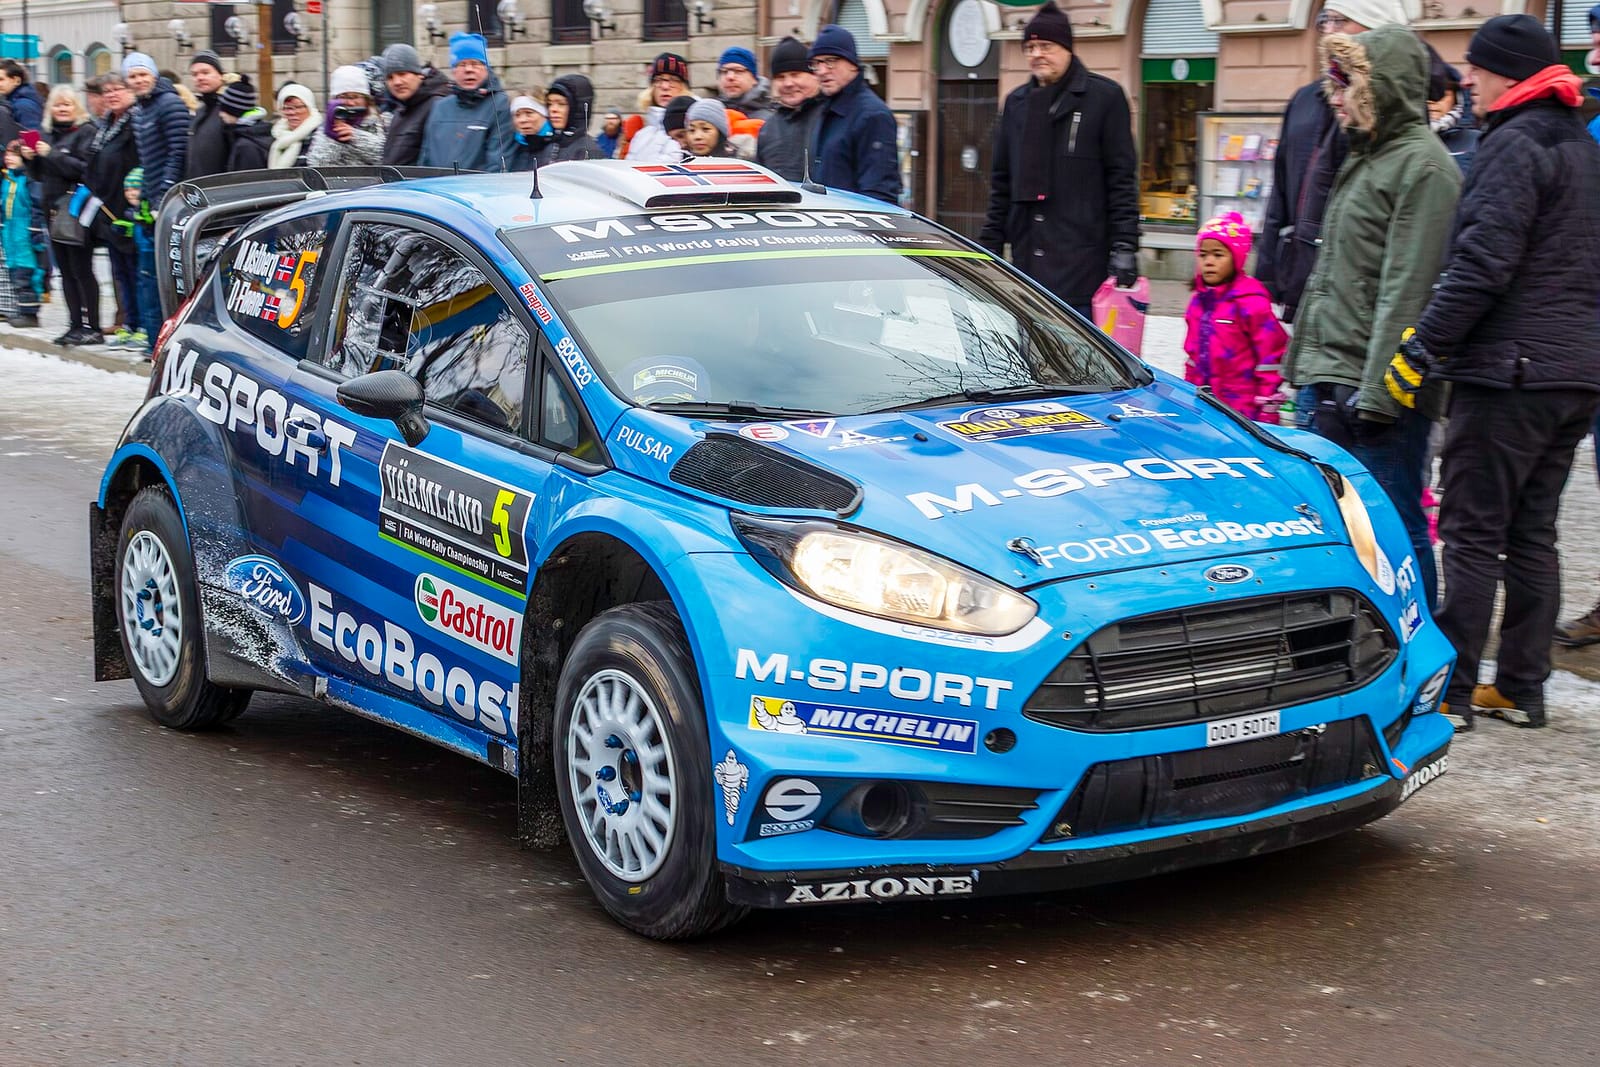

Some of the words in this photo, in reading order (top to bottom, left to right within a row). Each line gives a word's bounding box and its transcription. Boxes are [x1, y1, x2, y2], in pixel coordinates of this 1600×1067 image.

[551, 212, 896, 243] M-SPORT
[622, 245, 657, 255] FIA
[656, 239, 713, 252] World
[715, 236, 760, 248] Rally
[762, 234, 876, 245] Championship
[277, 250, 319, 329] 5
[557, 336, 592, 386] sparco
[655, 369, 696, 383] MICHELIN
[160, 342, 358, 488] M-SPORT
[949, 420, 1014, 435] RALLY
[1010, 411, 1096, 428] SWEDEN
[616, 425, 673, 464] PULSAR
[385, 458, 484, 535] VÄRMLAND
[491, 489, 516, 557] 5
[905, 457, 1275, 519] M-SPORT
[1037, 533, 1152, 569] FORD
[1150, 518, 1325, 550] EcoBoost
[1138, 515, 1191, 528] Powered
[1190, 512, 1208, 524] by
[403, 527, 414, 541] FIA
[414, 531, 431, 548] World
[431, 539, 447, 557] Rally
[447, 547, 489, 575] Championship
[241, 563, 293, 618] Ford
[439, 588, 514, 656] Castrol
[735, 648, 1013, 710] M-SPORT
[810, 708, 973, 743] MICHELIN
[785, 875, 973, 903] AZIONE
